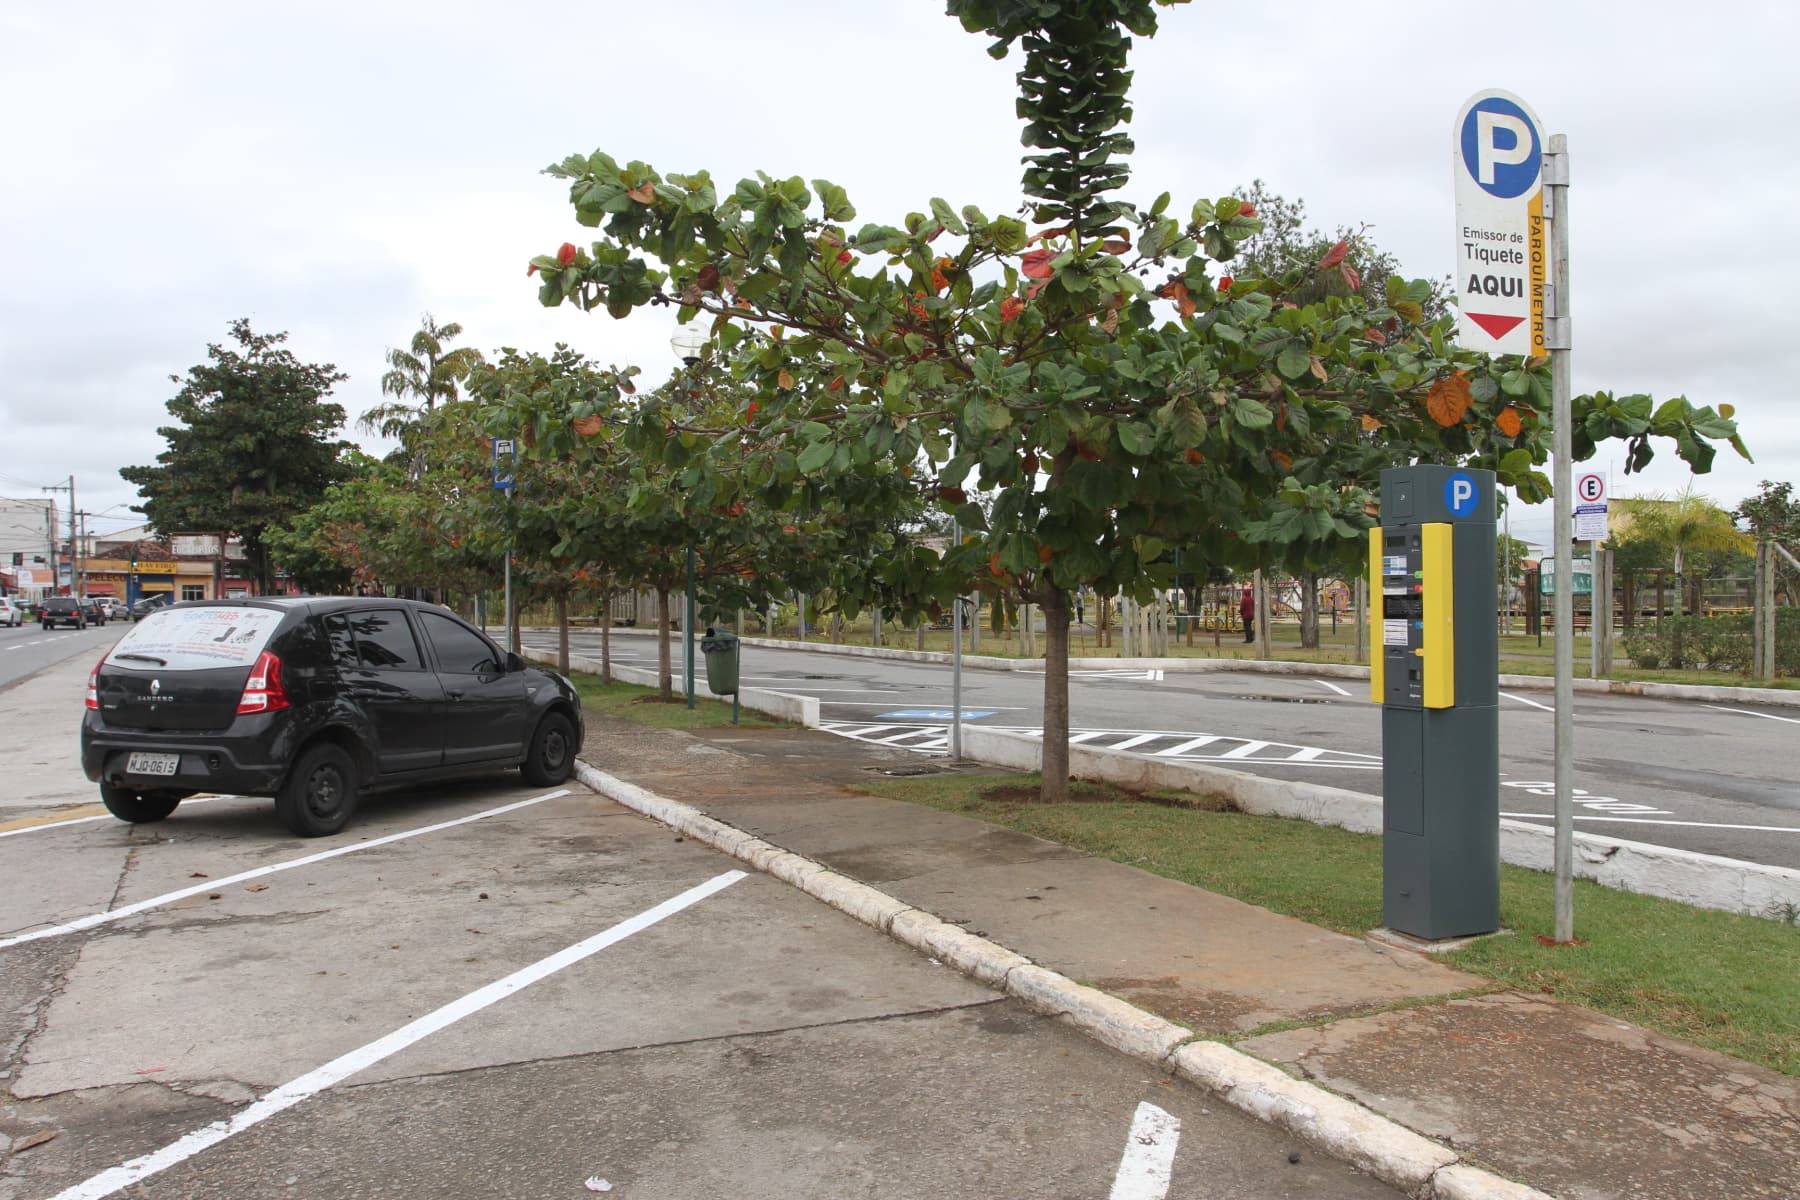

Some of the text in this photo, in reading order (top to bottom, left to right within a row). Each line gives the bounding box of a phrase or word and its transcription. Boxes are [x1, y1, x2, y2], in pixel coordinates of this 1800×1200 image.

[1476, 110, 1533, 185] P
[1463, 226, 1524, 244] Emissor de
[1463, 242, 1524, 266] Tíquete
[1467, 273, 1524, 298] AQUI
[1530, 215, 1544, 346] PARQUIMETRO
[1453, 479, 1473, 511] P
[1587, 480, 1596, 496] E
